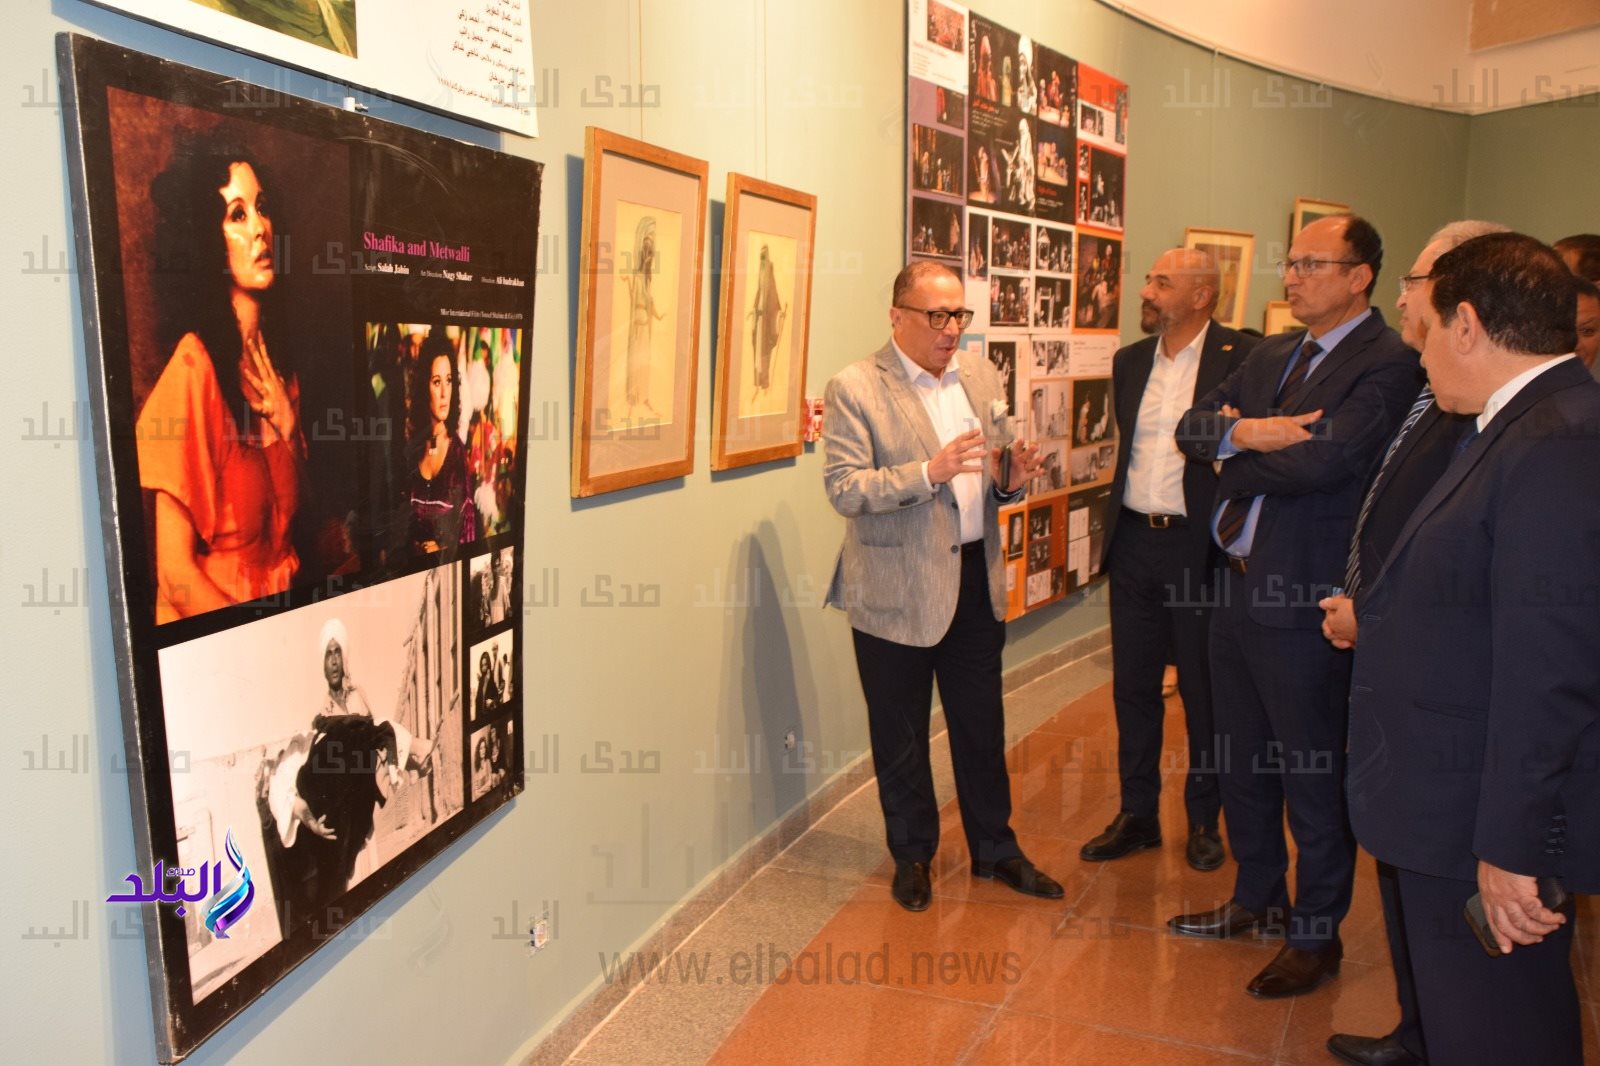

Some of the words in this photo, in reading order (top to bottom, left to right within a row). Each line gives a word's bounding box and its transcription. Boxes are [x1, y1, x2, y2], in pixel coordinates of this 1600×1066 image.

[364, 231, 405, 253] Shafika
[407, 239, 426, 257] and
[429, 241, 471, 263] Metwalli
[442, 269, 456, 282] Nagy
